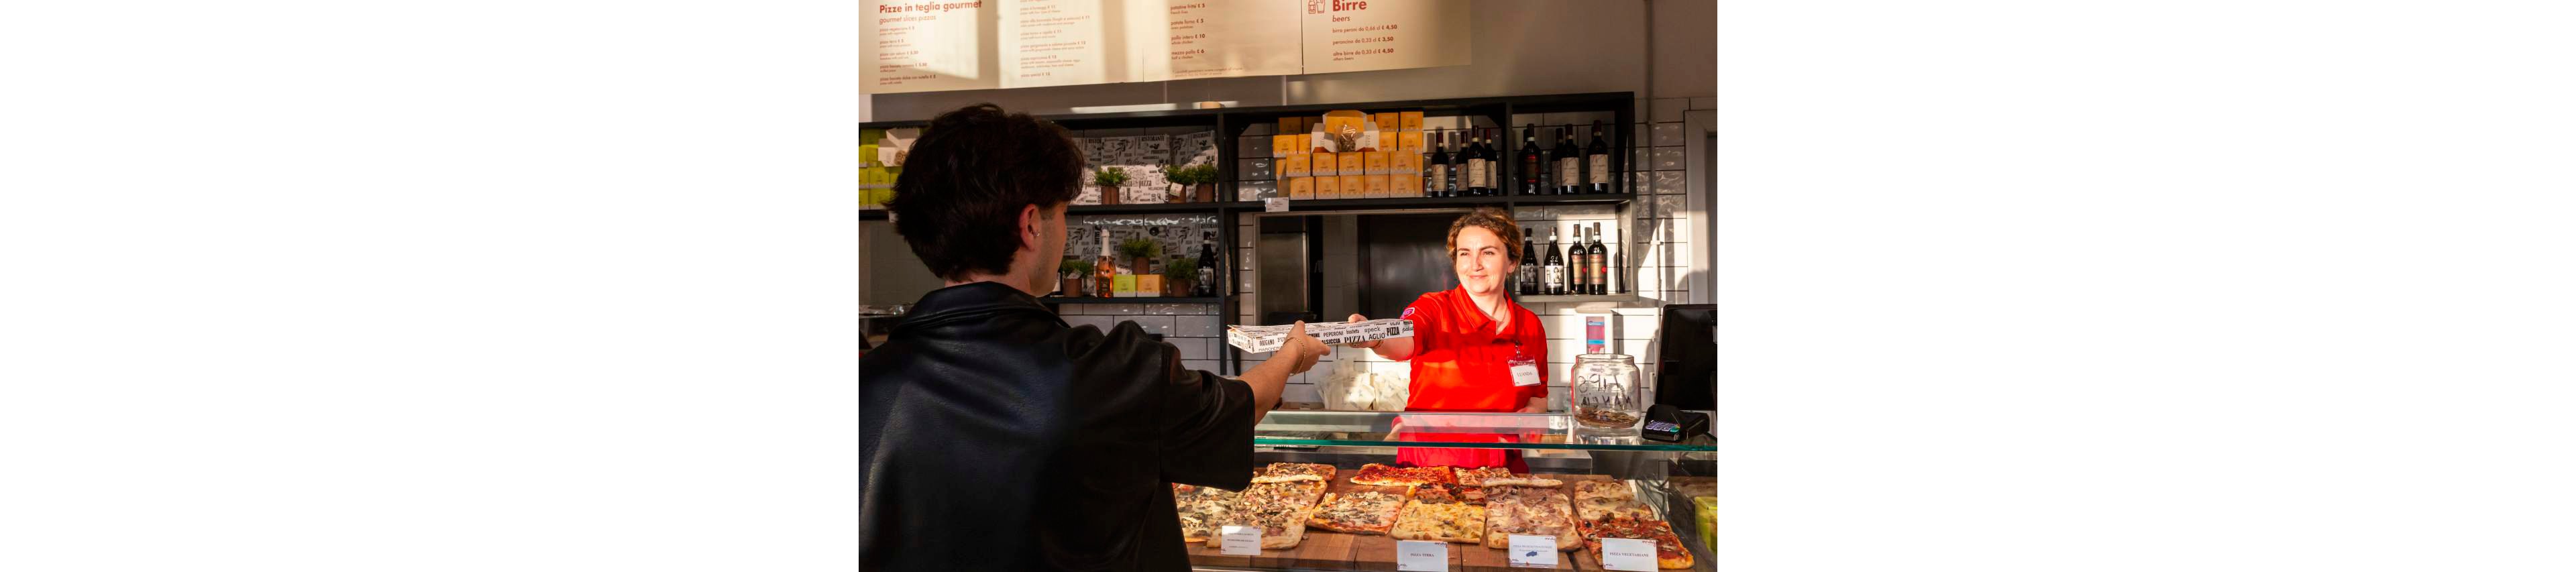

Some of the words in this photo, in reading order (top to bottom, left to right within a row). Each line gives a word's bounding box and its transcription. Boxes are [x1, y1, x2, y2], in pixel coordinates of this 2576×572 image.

[879, 4, 902, 13] Pizze
[905, 3, 913, 12] in
[916, 1, 941, 13] teglia
[943, 0, 982, 13] gourmet
[1332, 0, 1367, 11] Birre
[879, 17, 902, 25] gourmet
[918, 15, 936, 23] pizzas
[1138, 180, 1152, 188] pizza
[1364, 326, 1381, 334] speck
[1386, 327, 1400, 337] PIZZA
[1344, 335, 1366, 344] PIZZA
[1368, 333, 1385, 341] AGLIO
[1258, 338, 1275, 347] ORIGANO
